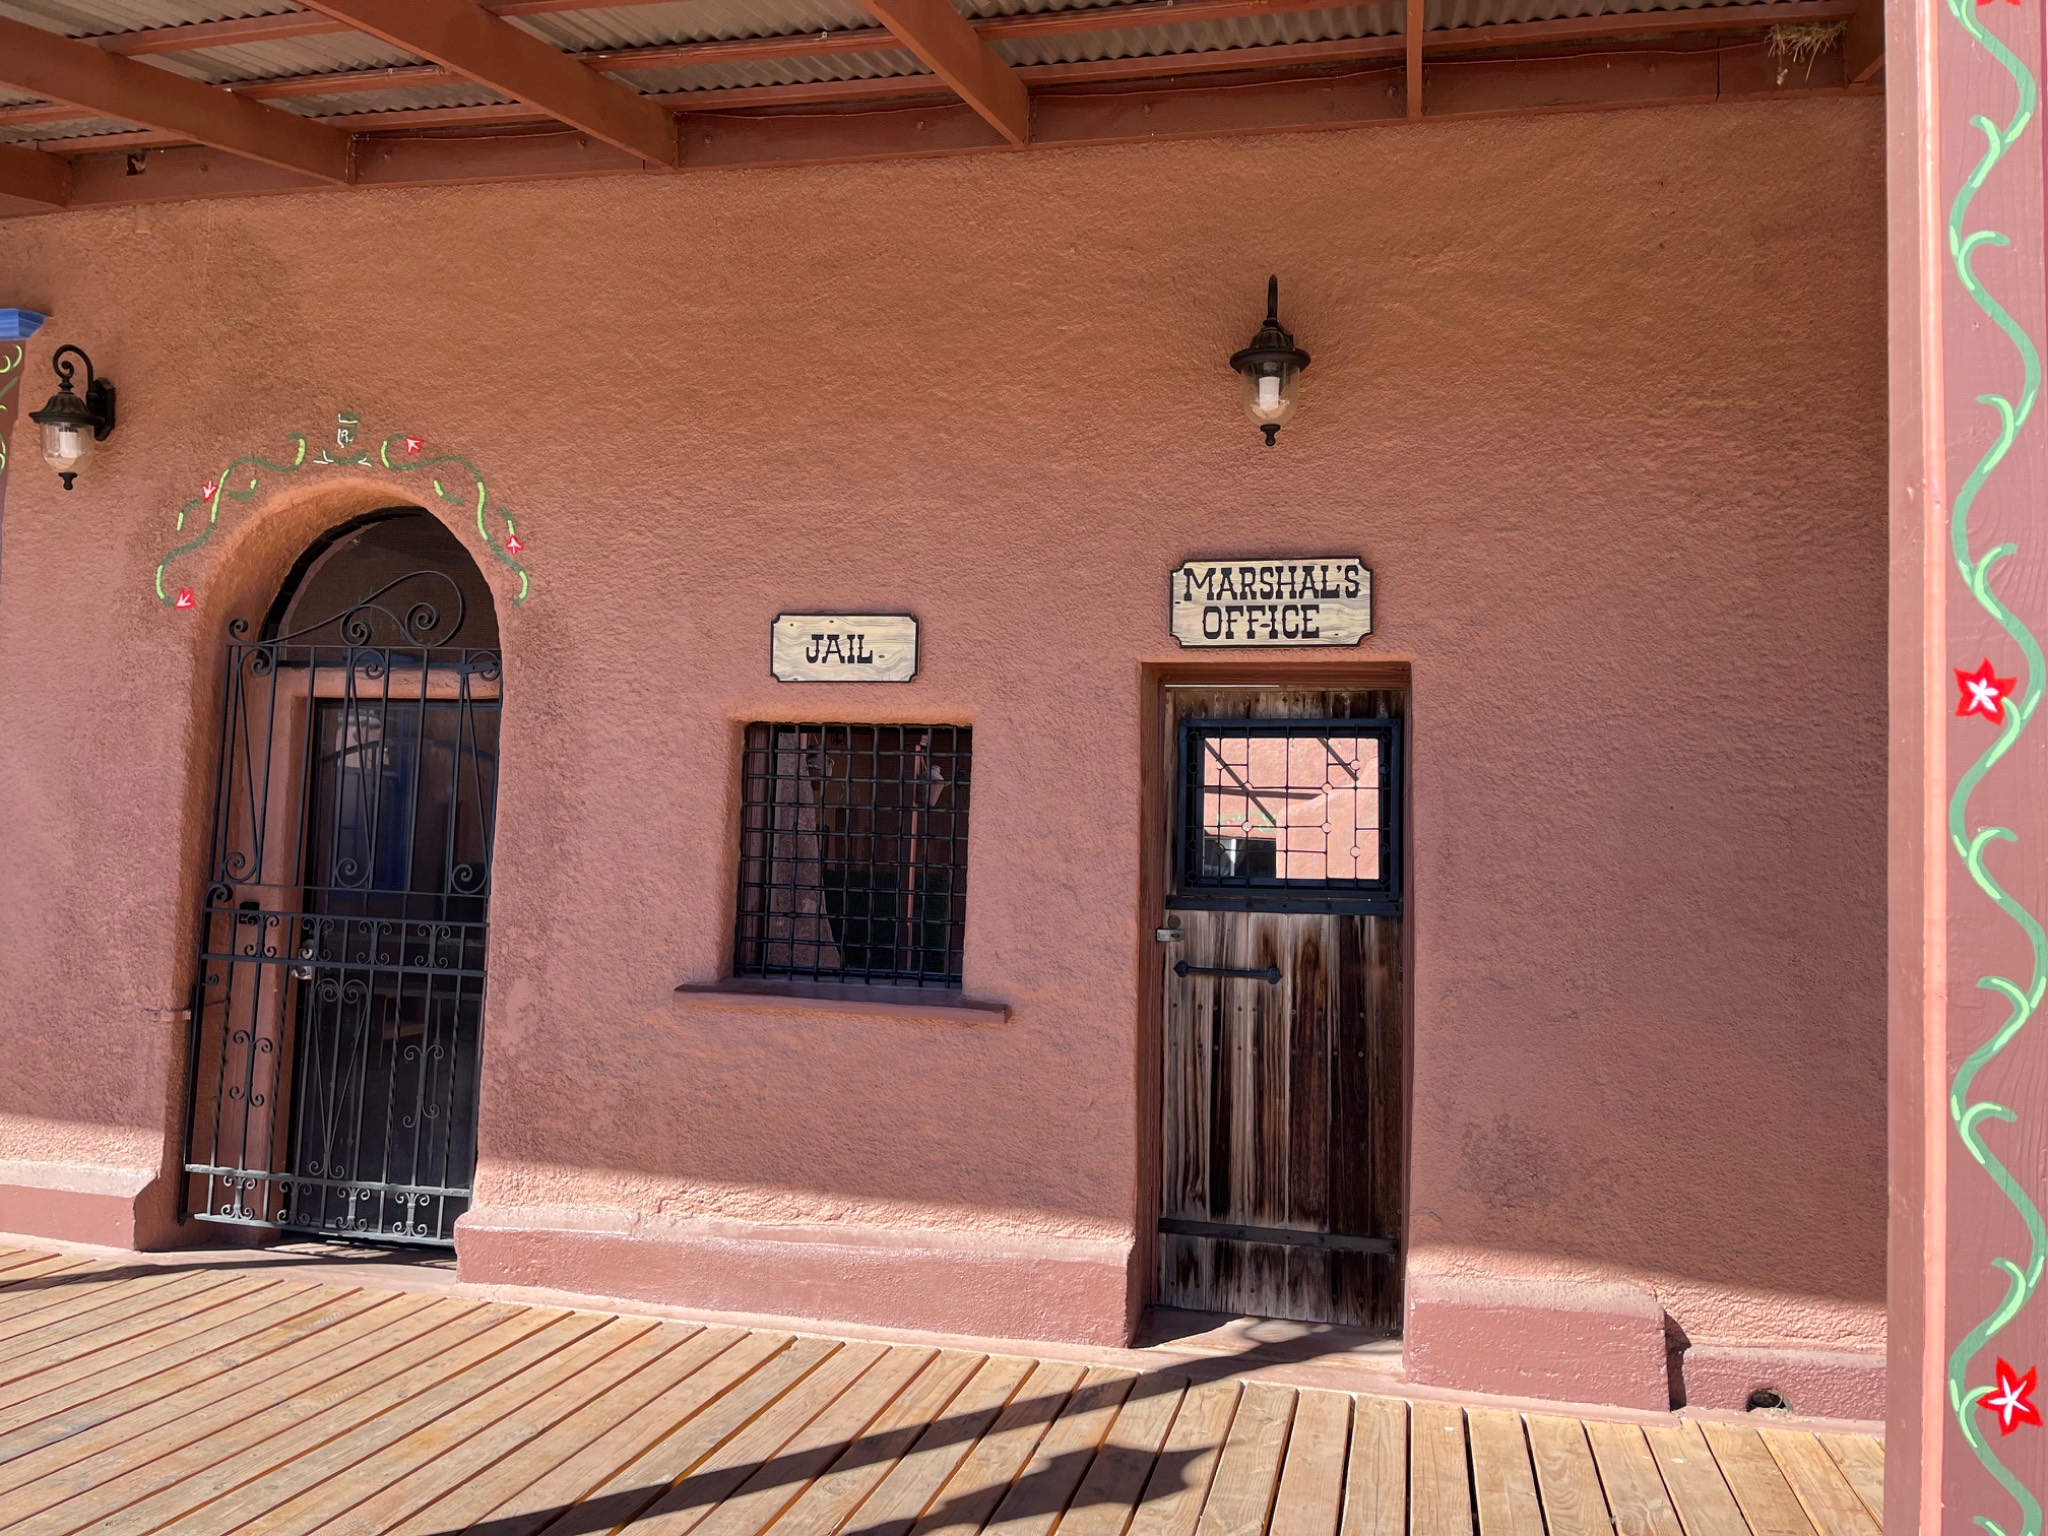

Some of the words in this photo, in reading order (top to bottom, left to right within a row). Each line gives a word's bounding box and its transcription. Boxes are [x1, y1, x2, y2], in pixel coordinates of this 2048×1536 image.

[1183, 565, 1360, 601] MARSHAL'S
[1202, 604, 1320, 640] OFFICE
[806, 634, 873, 664] JAIL
